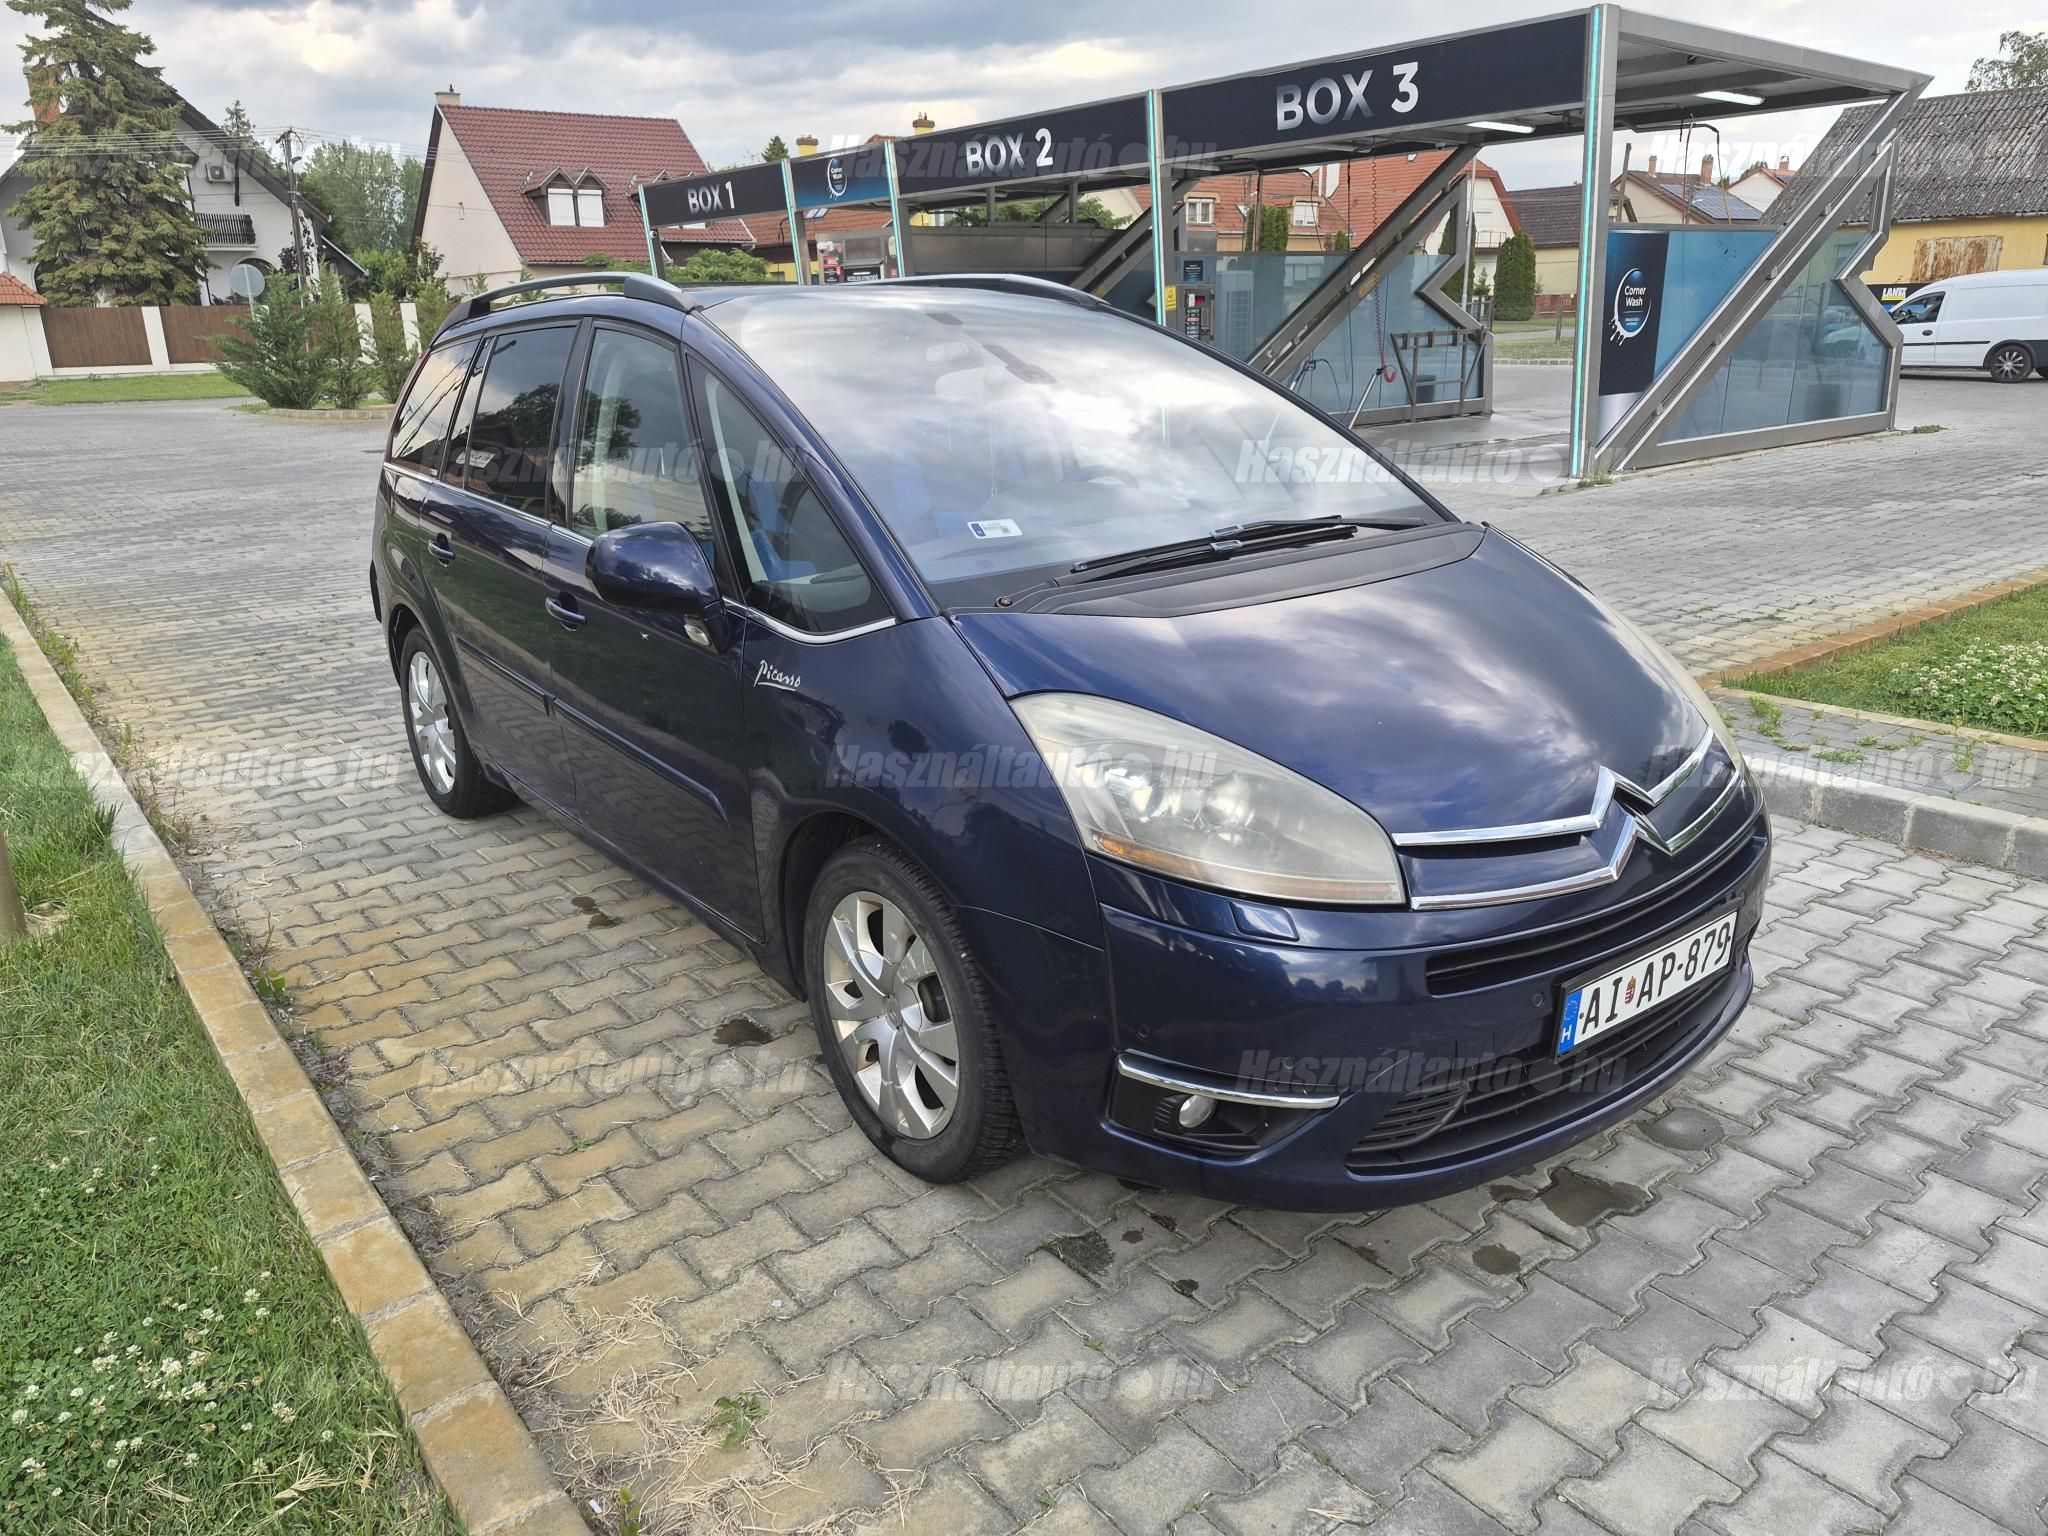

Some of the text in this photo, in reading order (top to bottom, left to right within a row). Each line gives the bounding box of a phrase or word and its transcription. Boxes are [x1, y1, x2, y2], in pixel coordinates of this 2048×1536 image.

[1276, 61, 1419, 131] BOX 3
[965, 128, 1053, 178] BOX 2
[687, 181, 735, 215] BOX 1
[1624, 285, 1647, 296] Corner
[1625, 296, 1643, 307] Wash
[754, 659, 801, 690] Picasso
[1582, 976, 1623, 1035] AI
[1560, 1025, 1573, 1043] H
